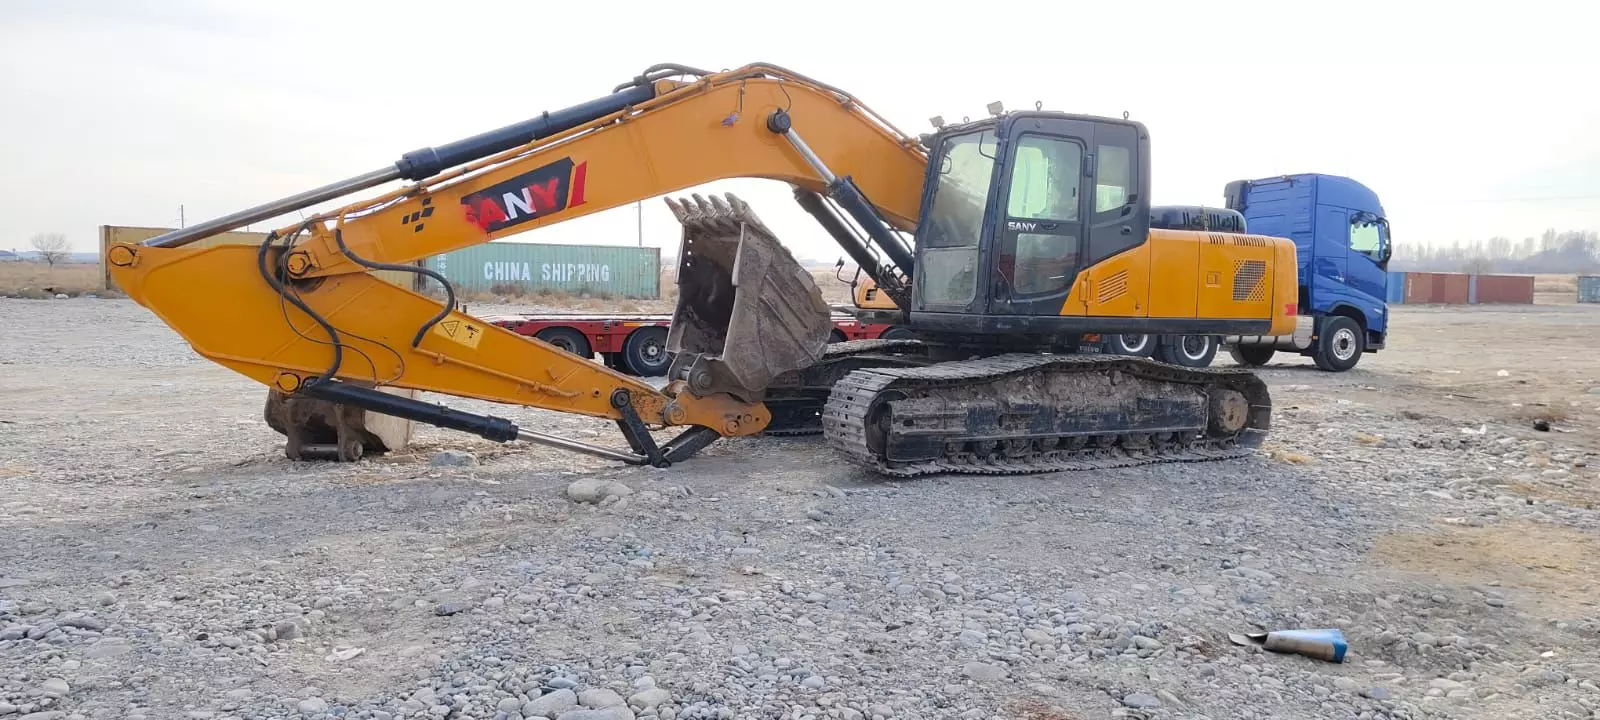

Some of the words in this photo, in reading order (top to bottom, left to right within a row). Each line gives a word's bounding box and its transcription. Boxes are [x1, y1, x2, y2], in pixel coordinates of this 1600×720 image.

[1007, 221, 1036, 231] SANY
[484, 261, 530, 281] CHINA
[542, 263, 610, 282] SHIPPING
